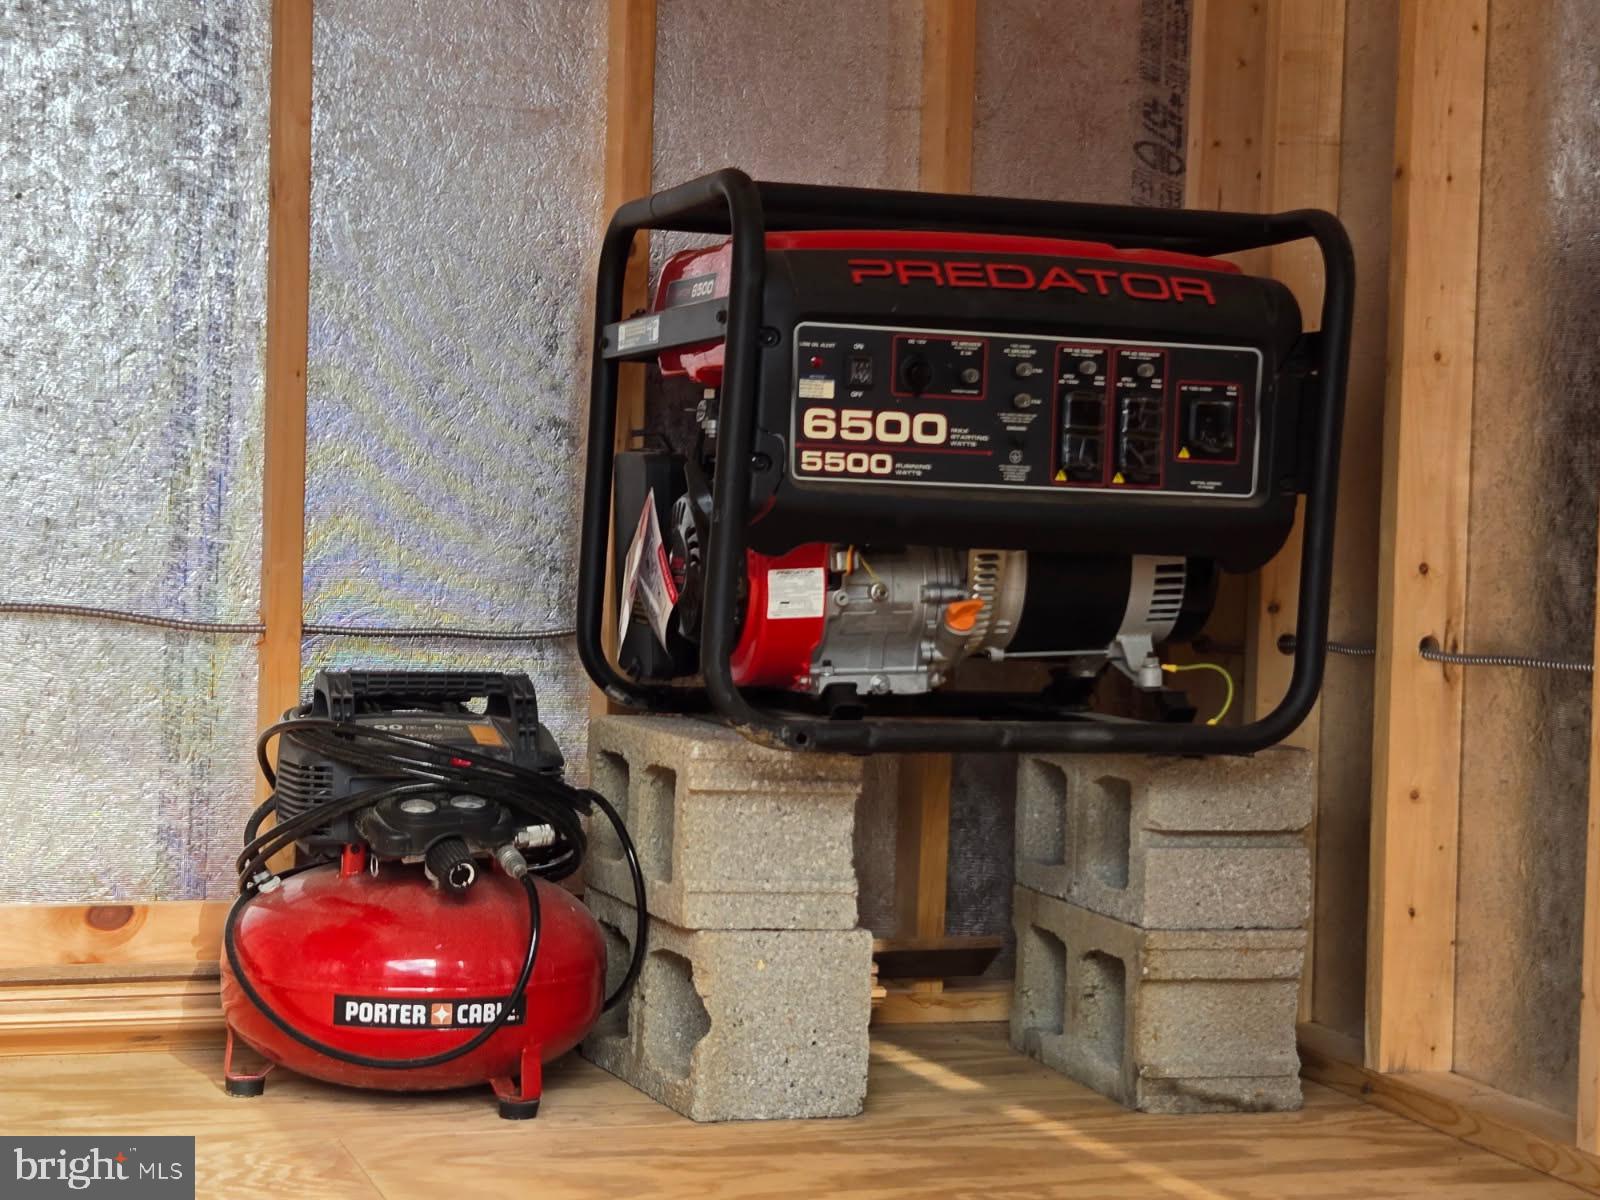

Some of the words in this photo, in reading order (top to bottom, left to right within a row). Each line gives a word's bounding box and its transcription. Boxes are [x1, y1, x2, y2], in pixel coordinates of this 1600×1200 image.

[848, 259, 1217, 305] PREDATOR
[803, 407, 948, 445] 6500
[801, 451, 893, 474] 5500
[345, 1001, 426, 1025] PORTER
